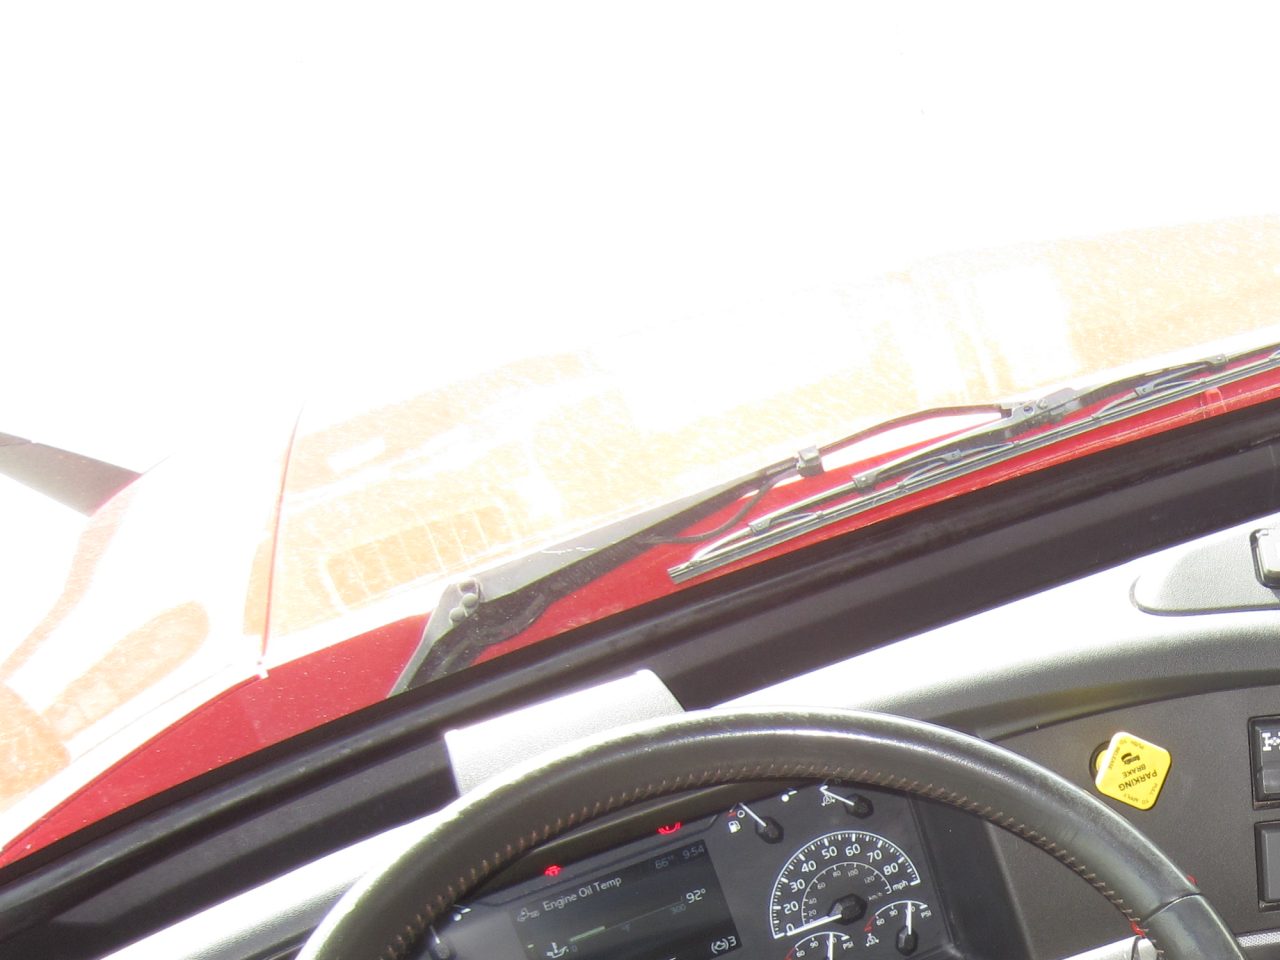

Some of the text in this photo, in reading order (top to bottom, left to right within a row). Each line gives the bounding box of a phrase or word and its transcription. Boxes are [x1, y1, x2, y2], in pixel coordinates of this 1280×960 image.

[1122, 763, 1147, 779] BRAKE
[1118, 769, 1158, 792] PARKING
[822, 846, 838, 860] 50
[845, 843, 861, 857] 60
[866, 850, 882, 863] 70
[801, 860, 817, 873] 40
[883, 863, 899, 876] 80
[789, 879, 806, 893] 30
[892, 879, 909, 892] mph
[542, 876, 623, 912] Engine Oil Temp
[783, 901, 799, 914] 20
